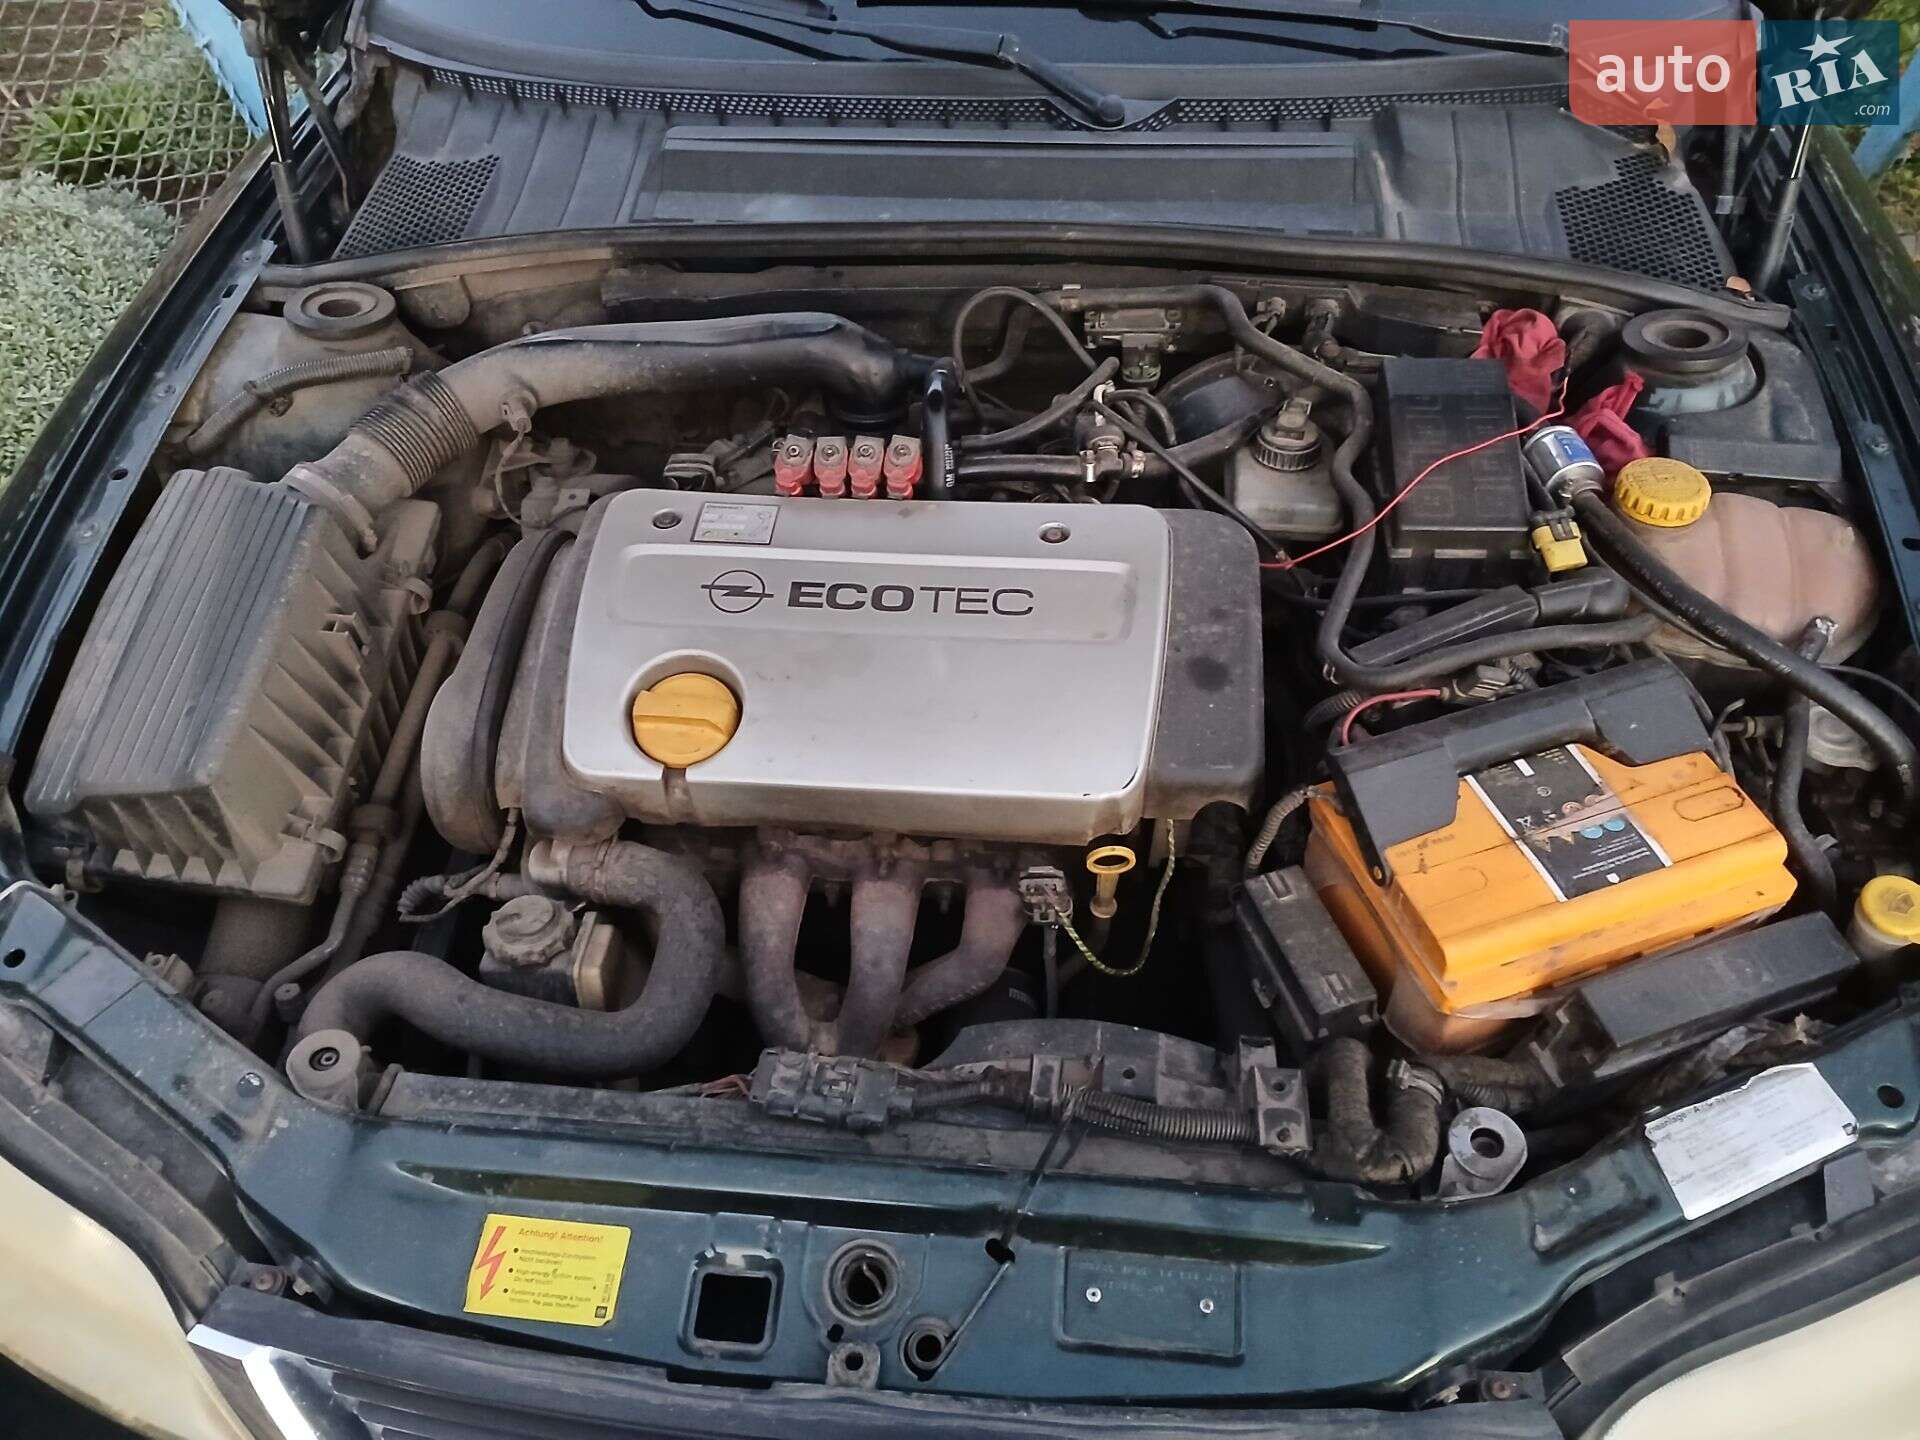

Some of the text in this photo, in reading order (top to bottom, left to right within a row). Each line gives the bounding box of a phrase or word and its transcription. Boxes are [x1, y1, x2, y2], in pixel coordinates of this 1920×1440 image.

[786, 580, 1034, 616] ECOTEC
[518, 1228, 604, 1243] Achtung! Attention!
